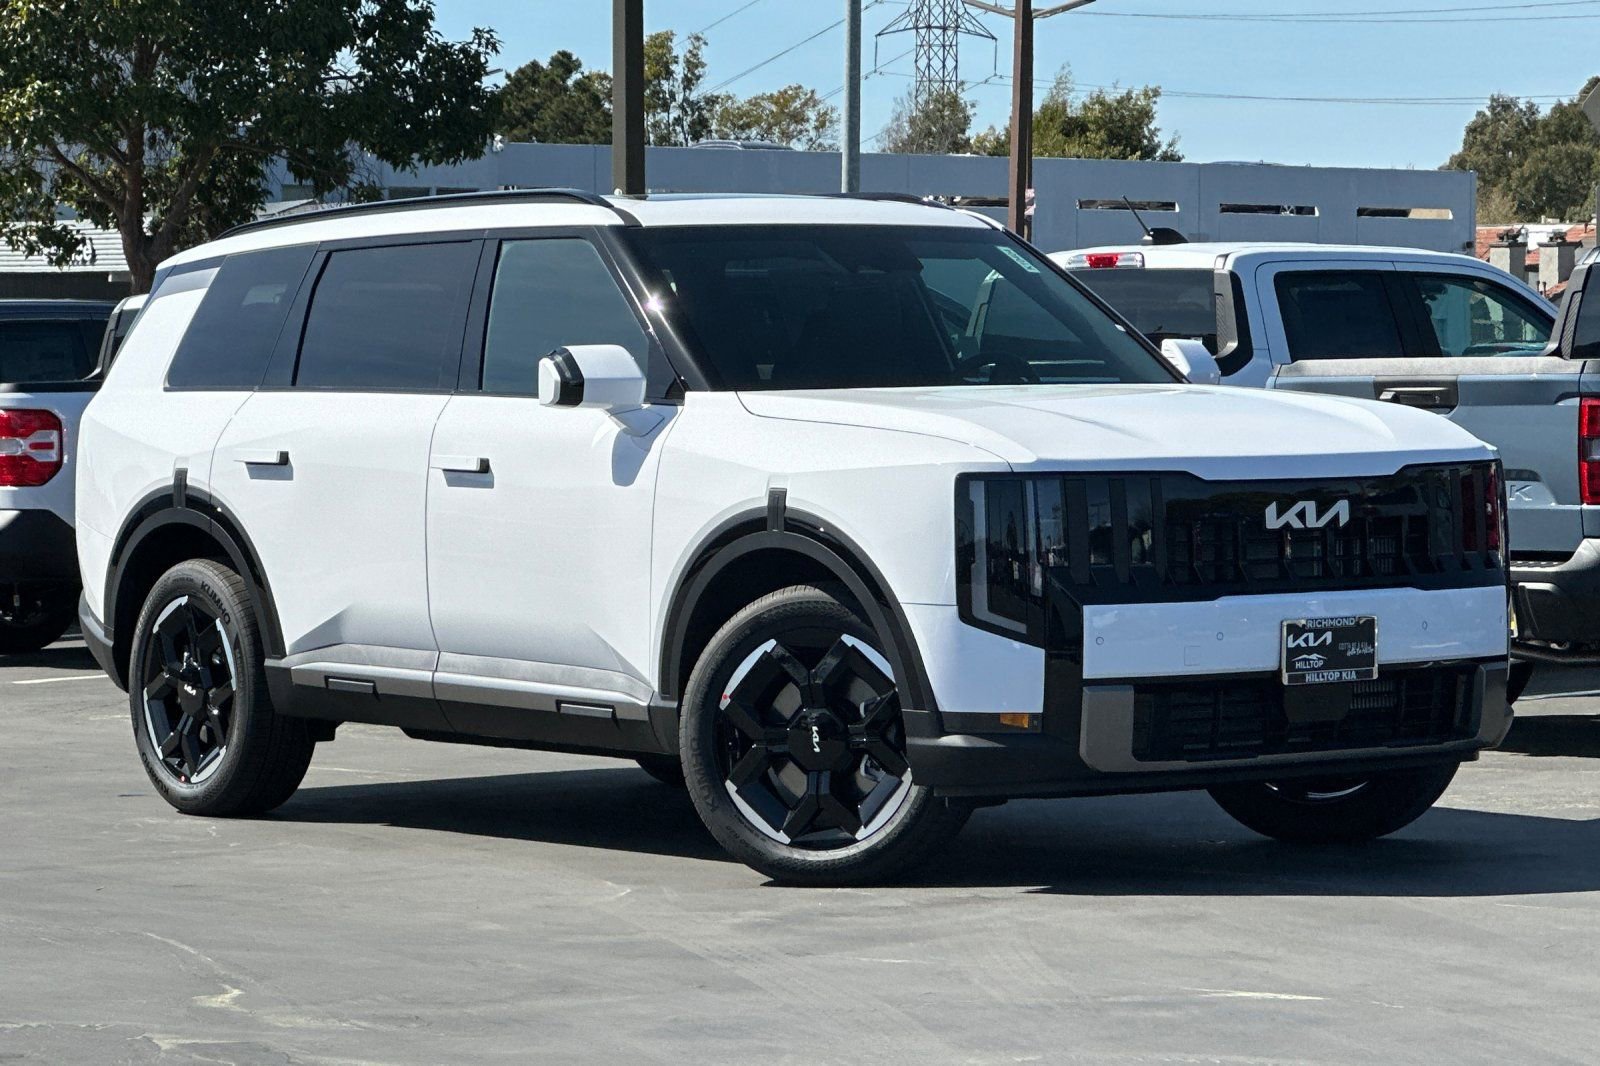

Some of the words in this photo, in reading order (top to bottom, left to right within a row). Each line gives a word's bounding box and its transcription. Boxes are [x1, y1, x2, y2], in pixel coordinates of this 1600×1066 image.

[1265, 500, 1349, 529] KIA
[201, 581, 231, 625] KUMHO
[1307, 618, 1355, 628] RICHMOND
[1287, 631, 1332, 648] KIA
[1296, 660, 1324, 669] HILLTOP
[1306, 671, 1340, 682] HILLTOP
[1342, 670, 1356, 680] KIA
[142, 752, 169, 795] KUMHO
